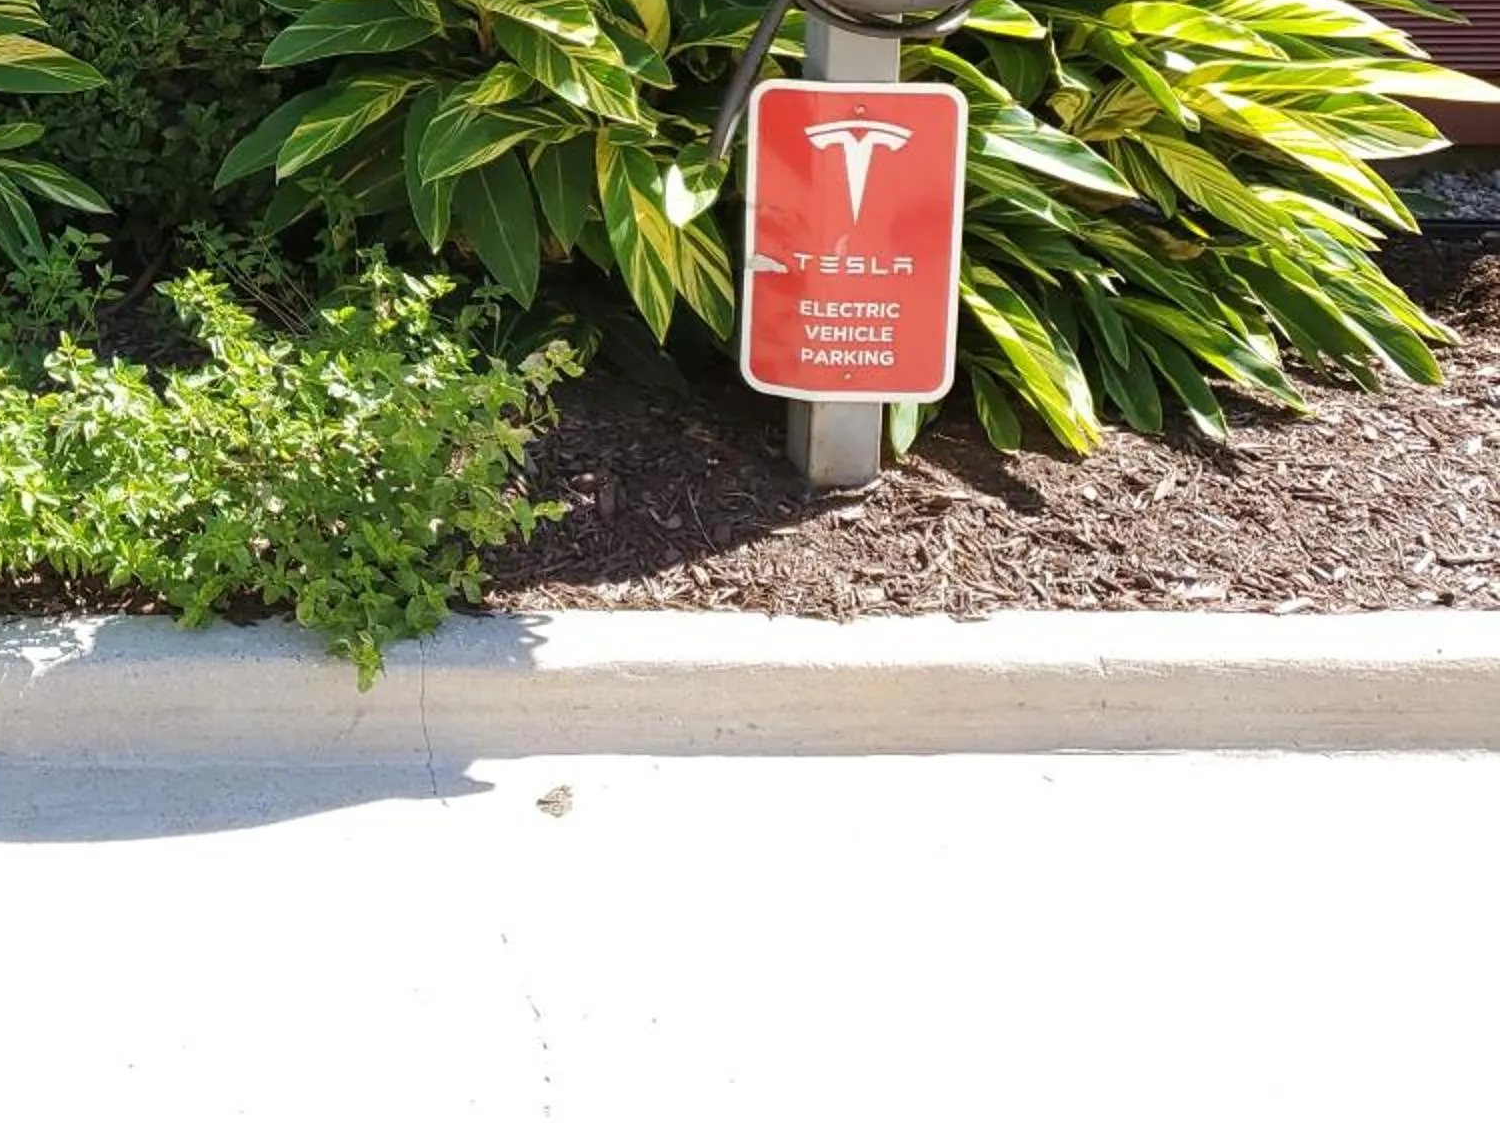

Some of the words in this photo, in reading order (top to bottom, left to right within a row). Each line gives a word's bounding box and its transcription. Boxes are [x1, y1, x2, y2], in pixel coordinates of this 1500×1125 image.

[793, 252, 914, 276] TESLA
[800, 300, 900, 318] ELECTRIC
[804, 325, 894, 342] VEHICLE
[801, 348, 894, 366] PARKING
